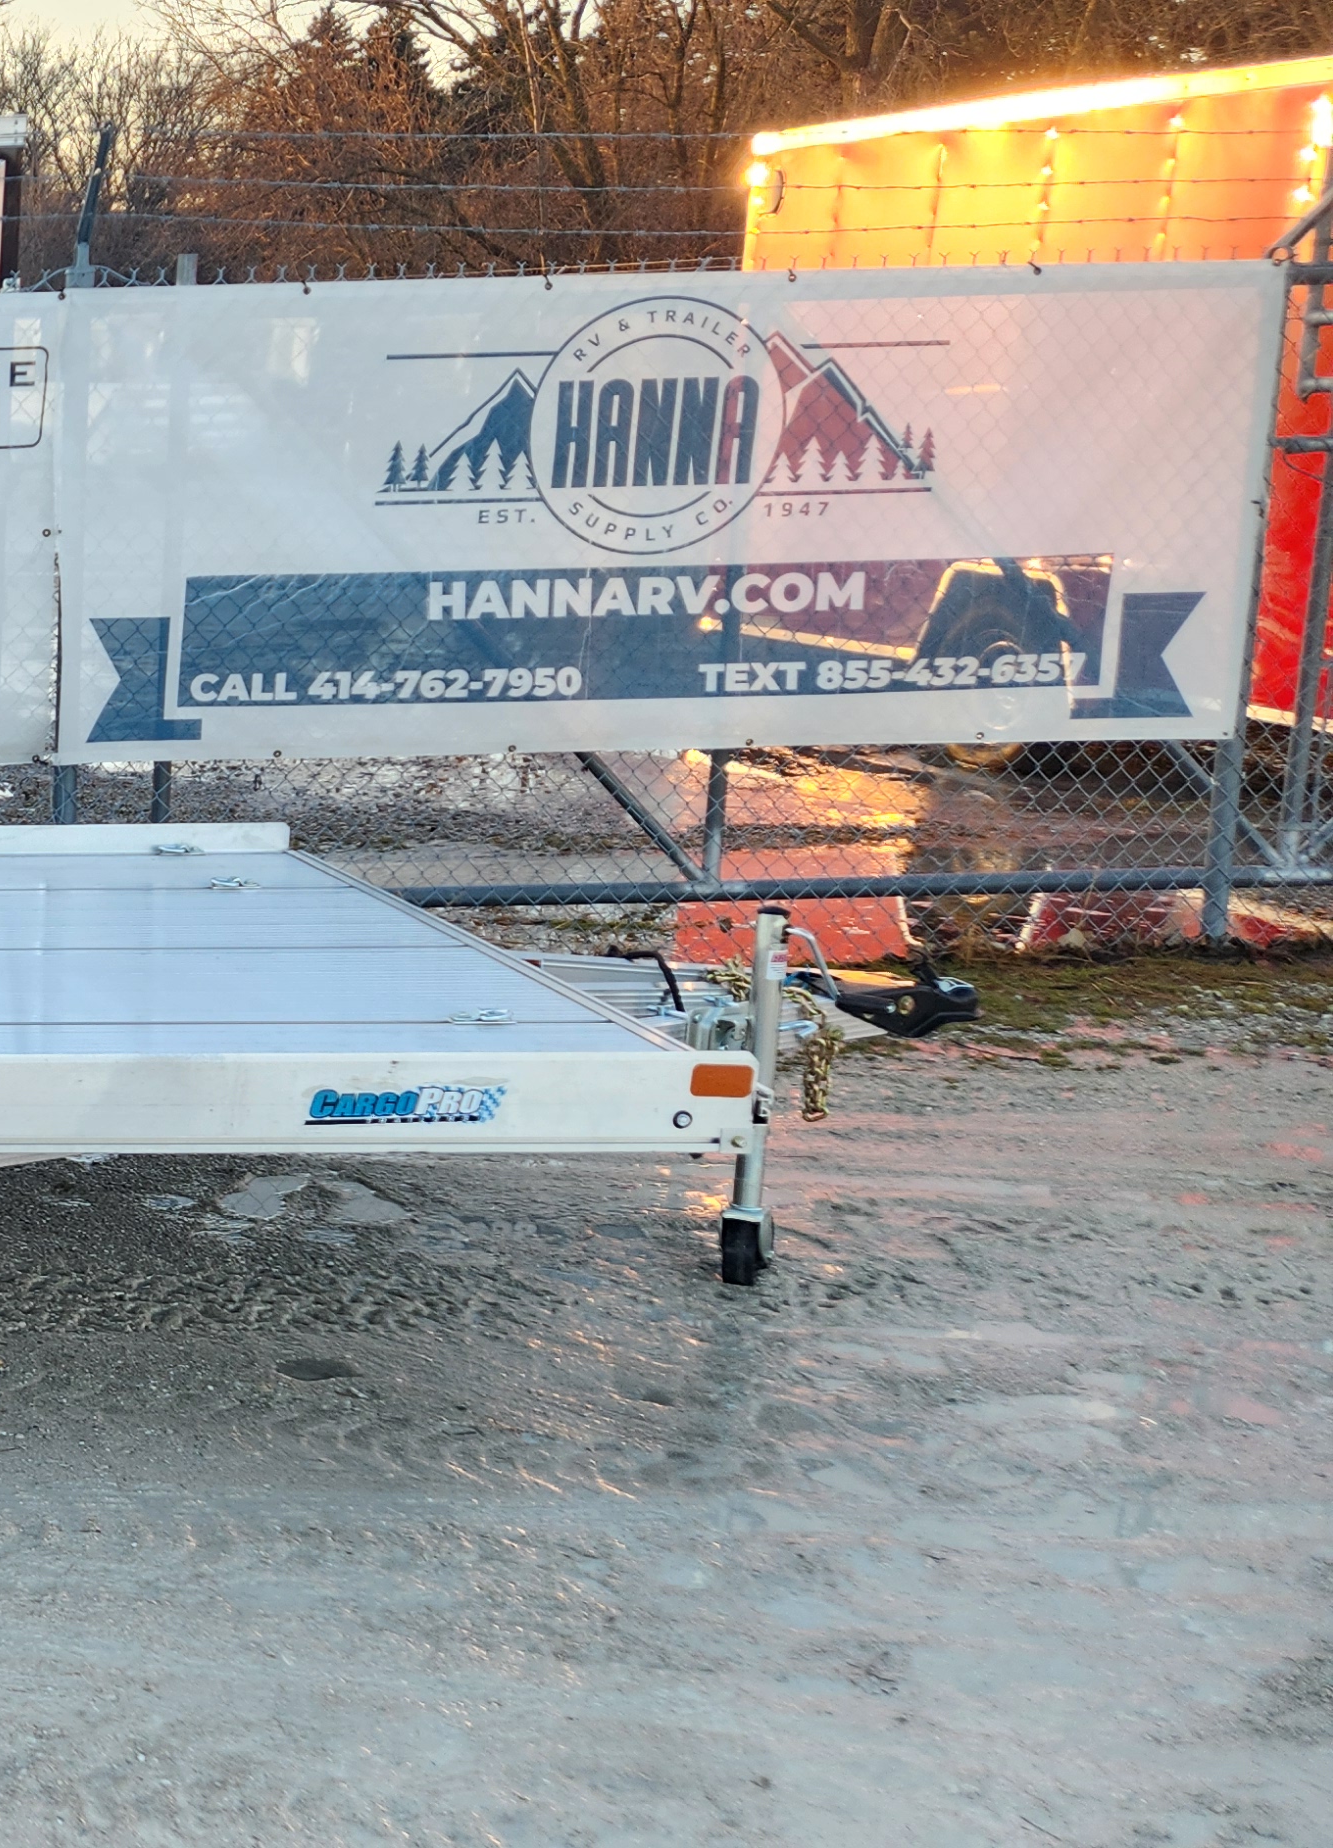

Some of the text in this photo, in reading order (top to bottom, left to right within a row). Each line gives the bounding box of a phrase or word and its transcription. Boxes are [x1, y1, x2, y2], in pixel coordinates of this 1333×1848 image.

[572, 309, 752, 362] RV & TRAILER
[550, 374, 760, 489] HANNA
[477, 508, 536, 524] EST.
[568, 498, 734, 542] SUPPLY CO.
[763, 501, 830, 518] 1947
[428, 571, 866, 621] HANNARV.COM
[190, 665, 583, 702] CALL 414-762-7950
[699, 652, 1088, 693] TEXT 855-432-6357
